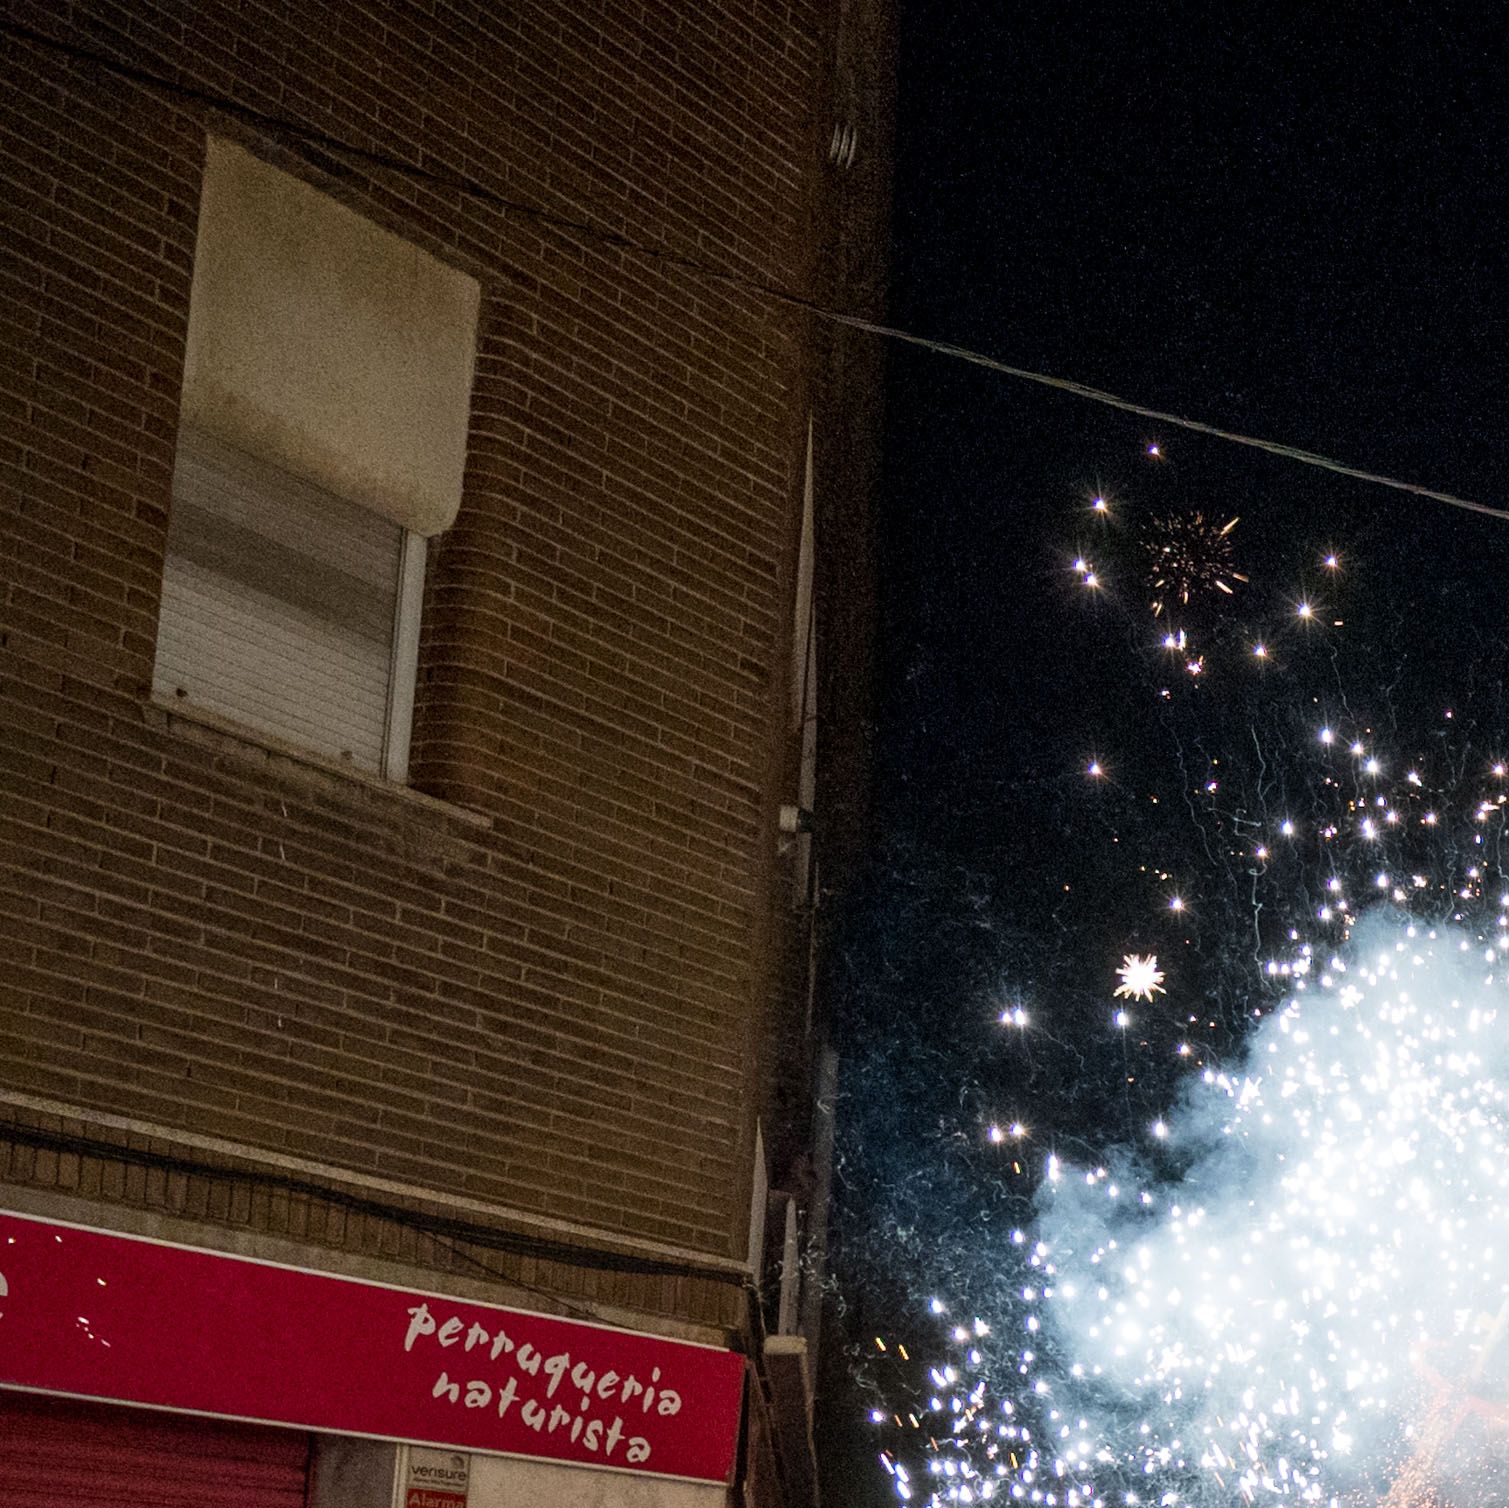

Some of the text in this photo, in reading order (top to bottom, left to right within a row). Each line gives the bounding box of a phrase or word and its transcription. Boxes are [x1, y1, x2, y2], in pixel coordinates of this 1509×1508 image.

[405, 1303, 682, 1416] perruqueria
[431, 1370, 652, 1465] naturista
[412, 1465, 466, 1481] verisure
